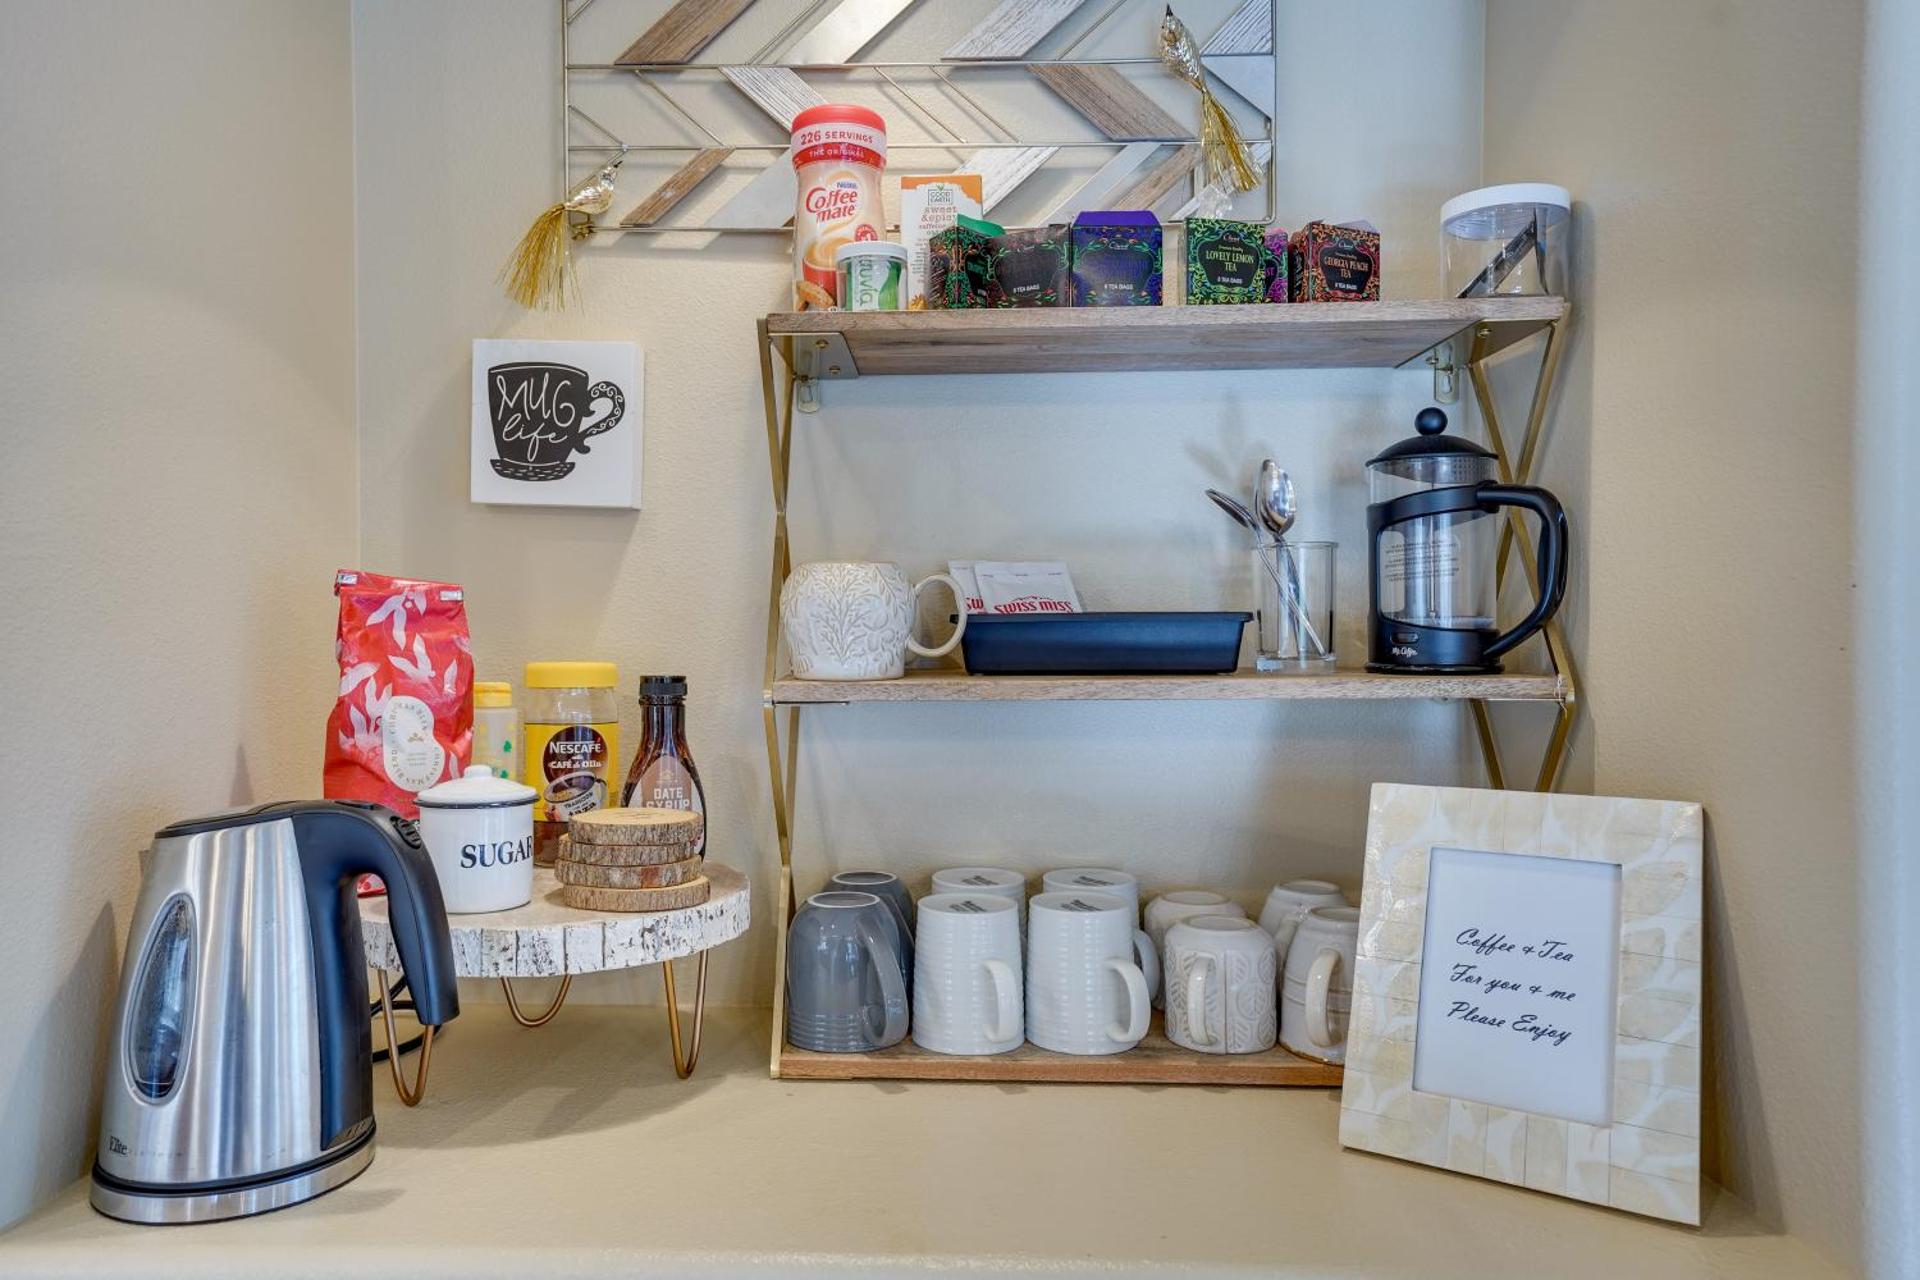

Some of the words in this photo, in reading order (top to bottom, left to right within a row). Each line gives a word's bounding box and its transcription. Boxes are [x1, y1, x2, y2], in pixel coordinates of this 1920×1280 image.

[800, 131, 820, 146] 226
[824, 131, 873, 144] SERVINGS
[809, 150, 824, 158] THE
[806, 187, 858, 213] Coffee
[816, 204, 856, 223] mate
[1206, 250, 1230, 261] LOVELY
[1232, 253, 1254, 264] LEMON
[1224, 262, 1238, 272] TEA
[1341, 268, 1352, 279] TEA
[496, 371, 576, 427] MUG
[502, 412, 568, 462] life
[994, 600, 1038, 614] SWISS
[1039, 600, 1073, 613] MISS
[654, 787, 684, 800] DATE
[1456, 928, 1516, 956] Coffee
[1522, 946, 1536, 954] &
[1538, 939, 1574, 962] Tea
[1450, 963, 1481, 983] For
[1484, 978, 1522, 994] you
[1529, 985, 1542, 994] &
[1547, 989, 1576, 1001] me
[1448, 1001, 1506, 1028] Please
[1512, 1014, 1572, 1046] Enjoy
